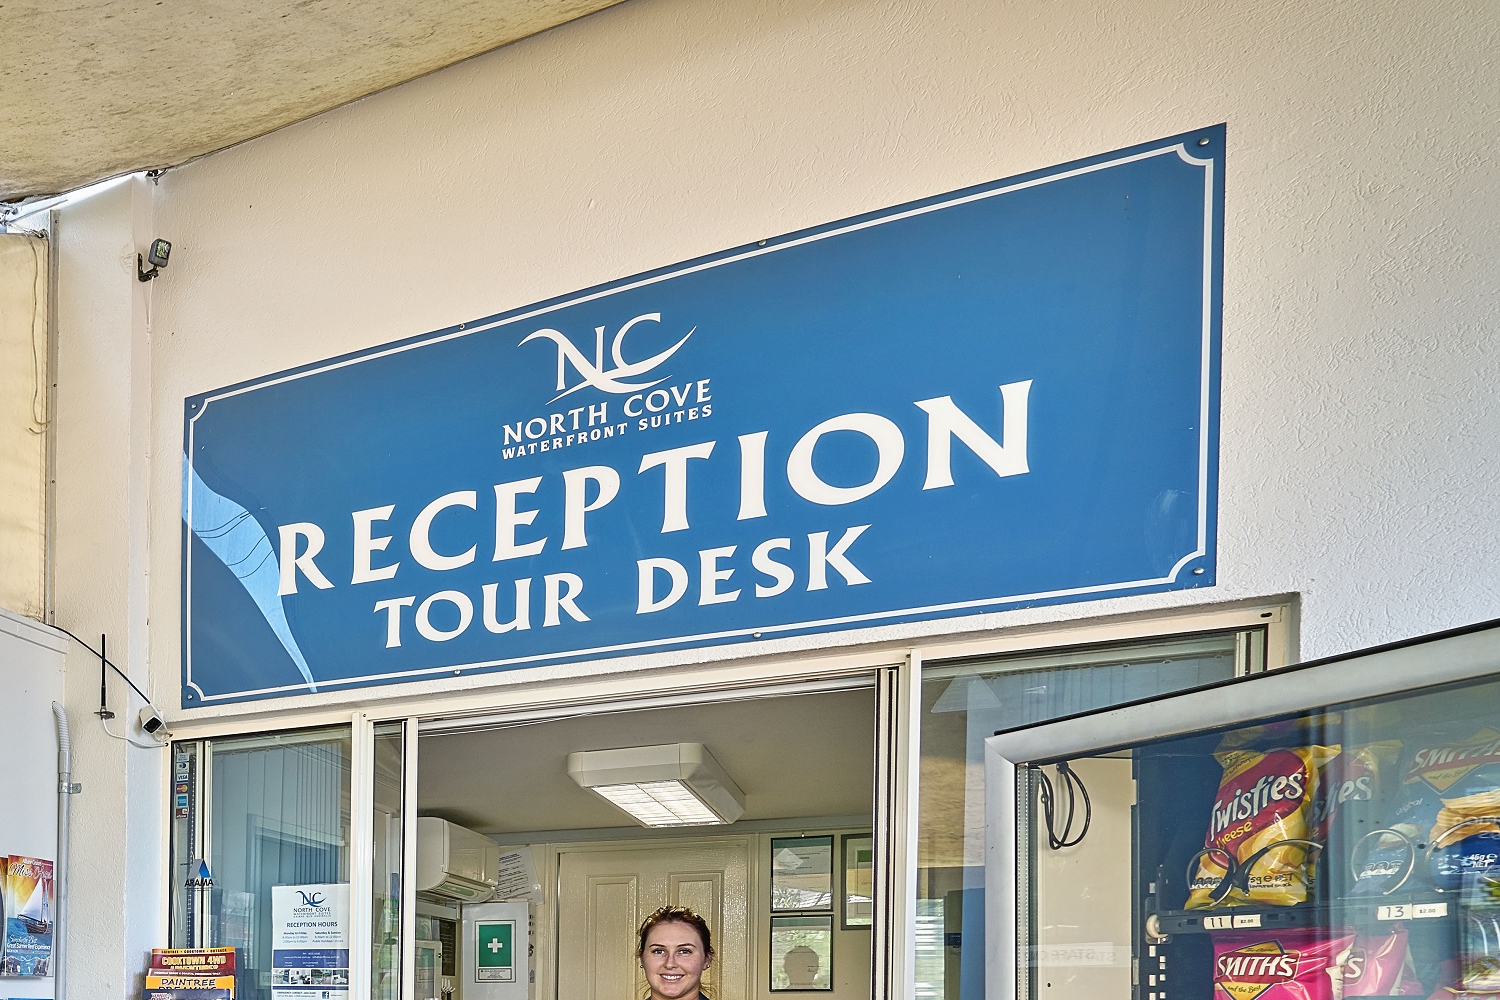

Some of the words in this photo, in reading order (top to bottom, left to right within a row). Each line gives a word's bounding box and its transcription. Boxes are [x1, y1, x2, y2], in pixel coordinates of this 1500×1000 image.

[501, 423, 627, 460] WATERFRONT
[638, 404, 714, 433] SUITES
[502, 401, 609, 447] NORTH
[622, 378, 713, 420] COVE
[276, 380, 1034, 598] RECEPTION
[373, 571, 590, 650] TOUR
[635, 523, 873, 615] DESK
[1210, 771, 1303, 841] Twisties
[1386, 906, 1404, 918] 13
[1217, 953, 1297, 977] SMITH'S
